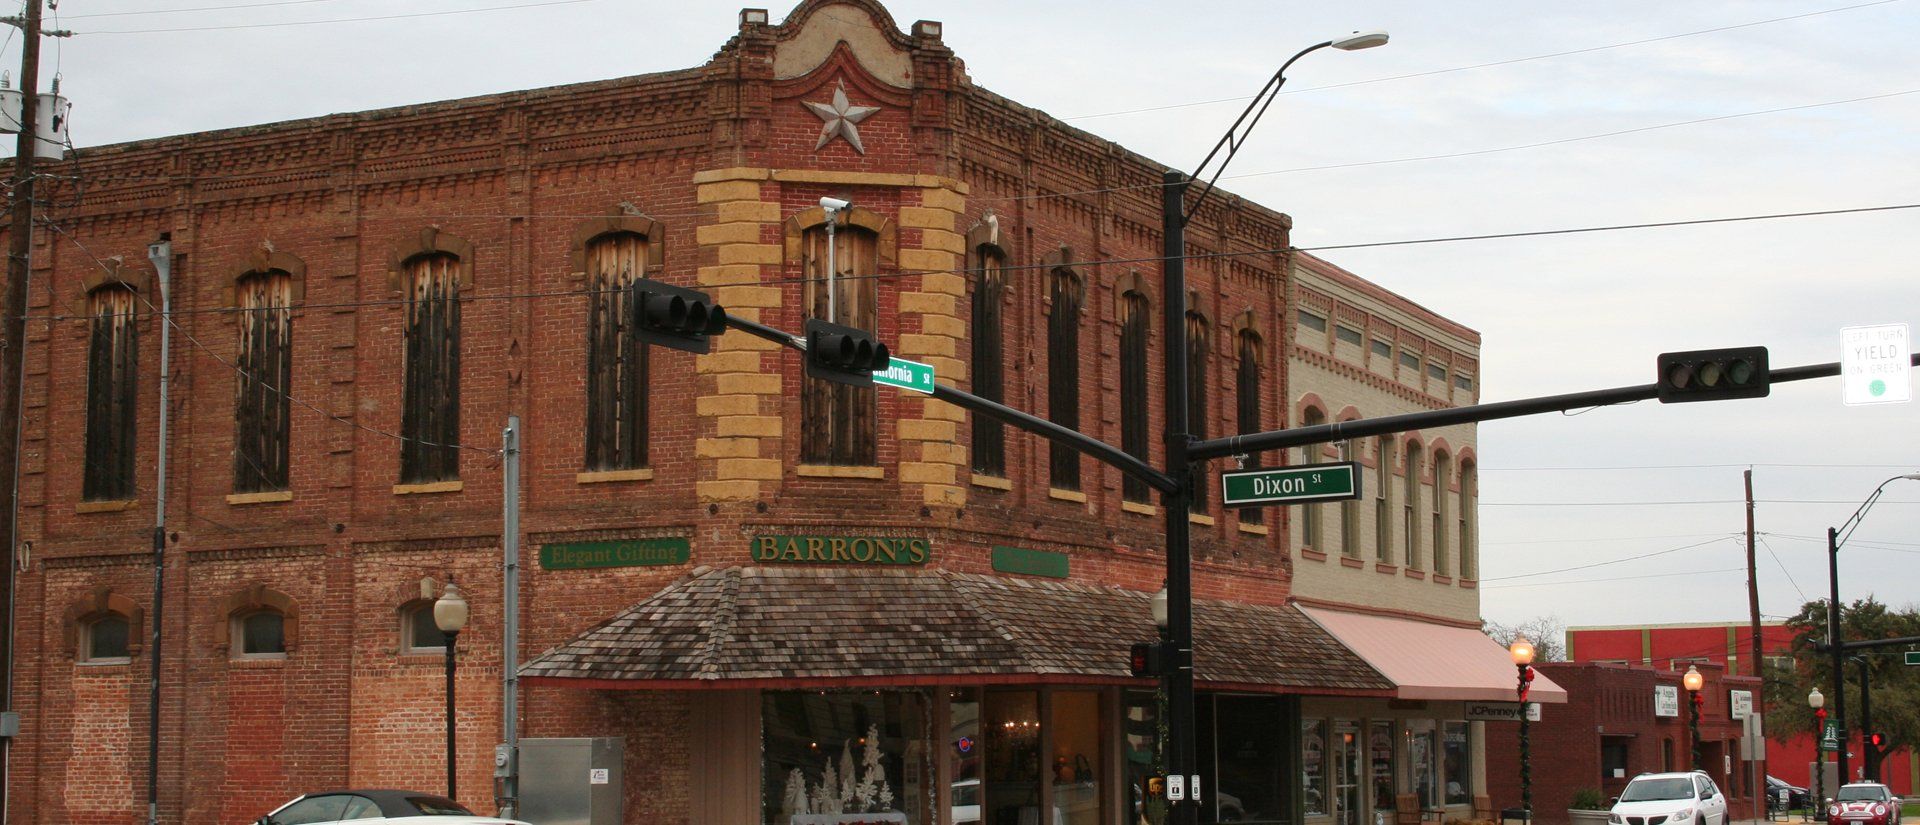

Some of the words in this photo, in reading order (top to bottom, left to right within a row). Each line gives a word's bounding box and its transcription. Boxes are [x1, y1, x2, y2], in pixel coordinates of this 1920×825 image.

[1876, 328, 1903, 341] TURN
[1854, 344, 1897, 361] YIELD
[1849, 365, 1863, 376] ON
[1870, 362, 1902, 374] GREEN
[1253, 475, 1305, 496] Dixon
[1311, 473, 1322, 484] St
[551, 545, 611, 566] Elegant
[616, 542, 678, 562] Gifting
[758, 536, 925, 563] BARRON'S
[1468, 705, 1516, 718] JCPenney
